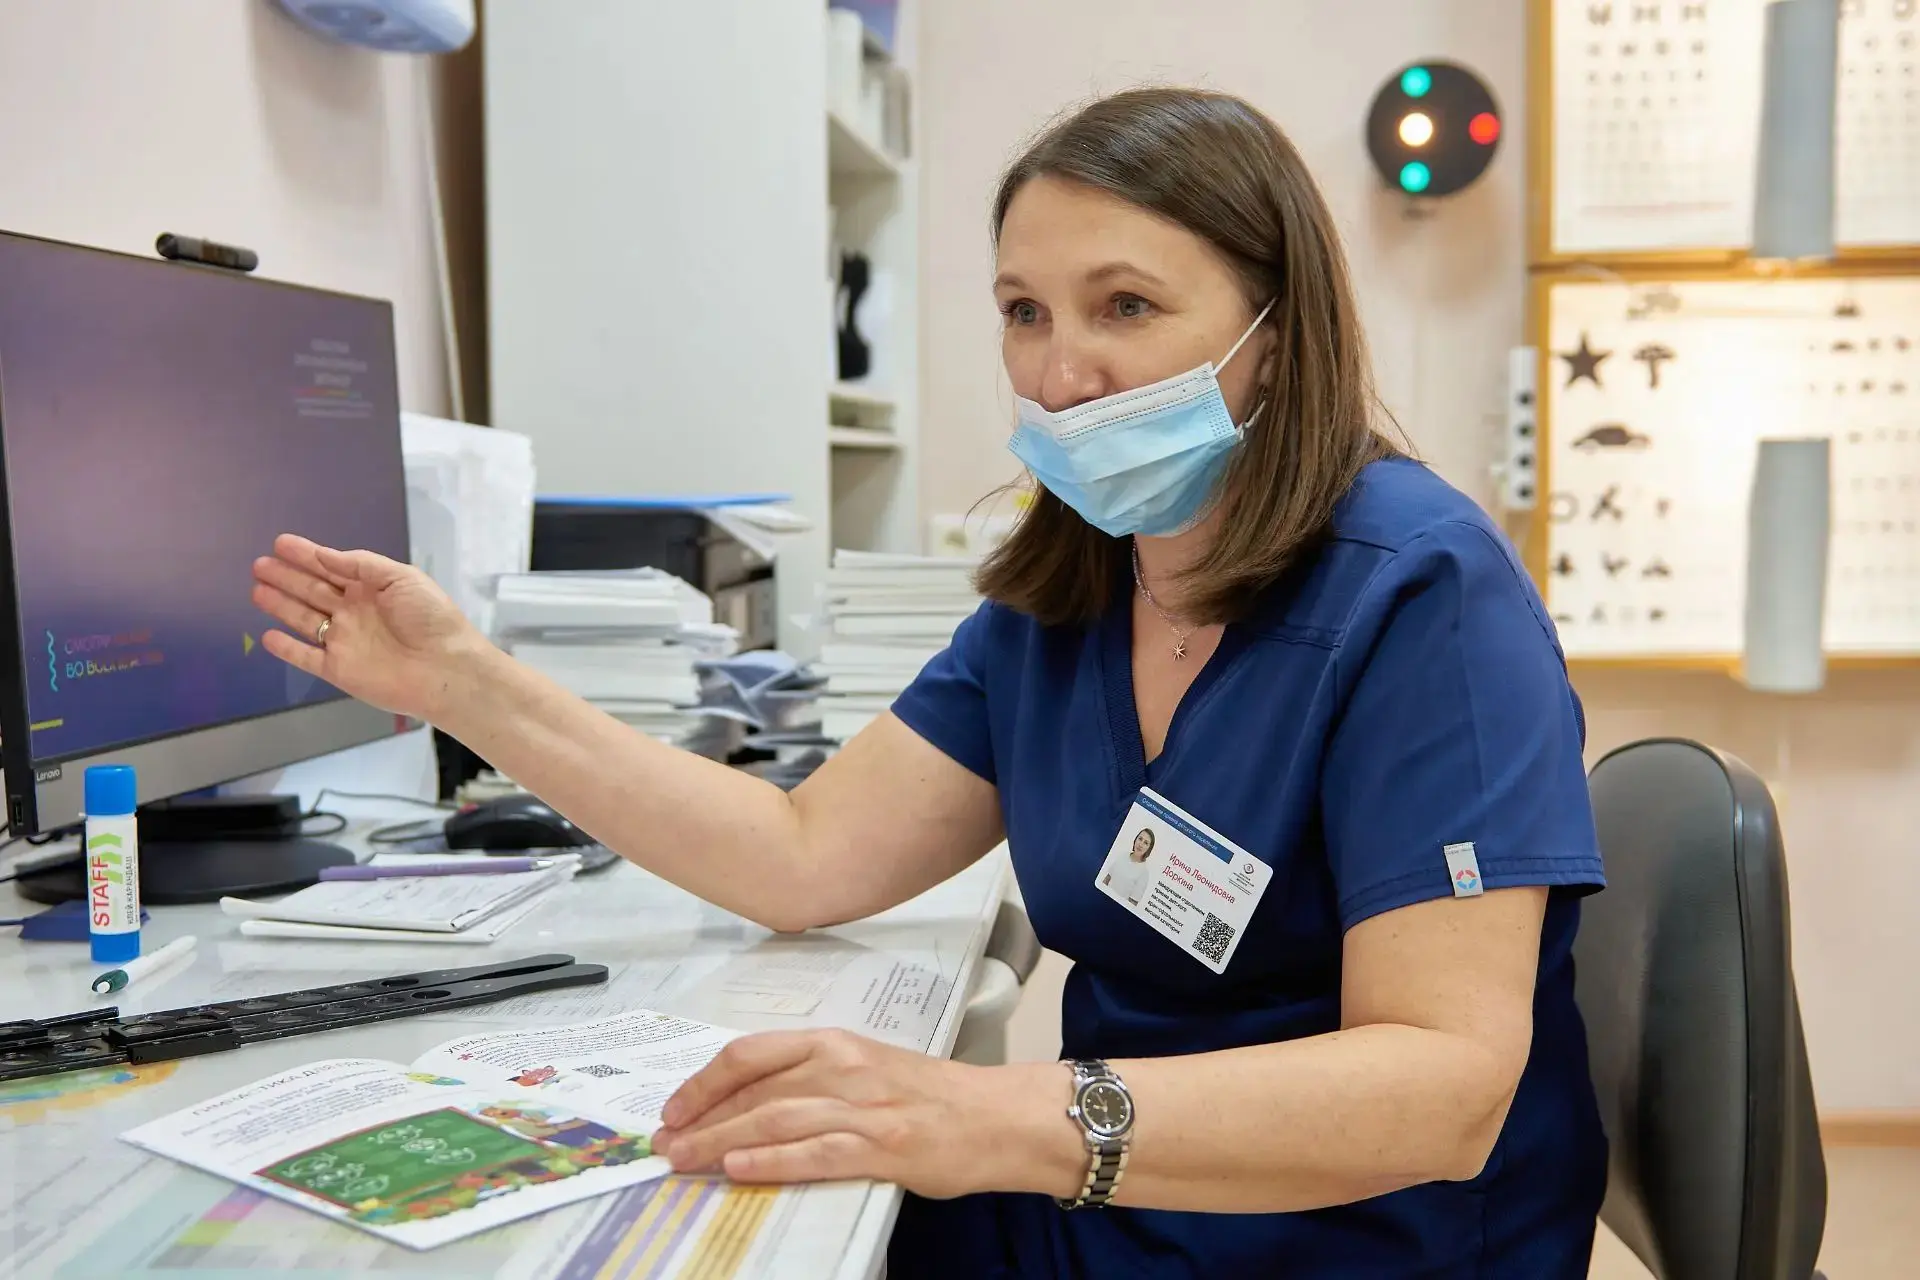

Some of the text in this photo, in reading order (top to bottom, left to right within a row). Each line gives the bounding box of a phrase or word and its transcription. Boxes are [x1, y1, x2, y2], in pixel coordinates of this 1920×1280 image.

[36, 769, 61, 782] Lenovo
[92, 856, 110, 927] STAFF
[125, 856, 134, 925] КЛЕЙ КАРАНДАШ
[1162, 865, 1194, 892] Доркина
[1169, 853, 1192, 875] Ирина
[1191, 869, 1236, 904] Леонидовна
